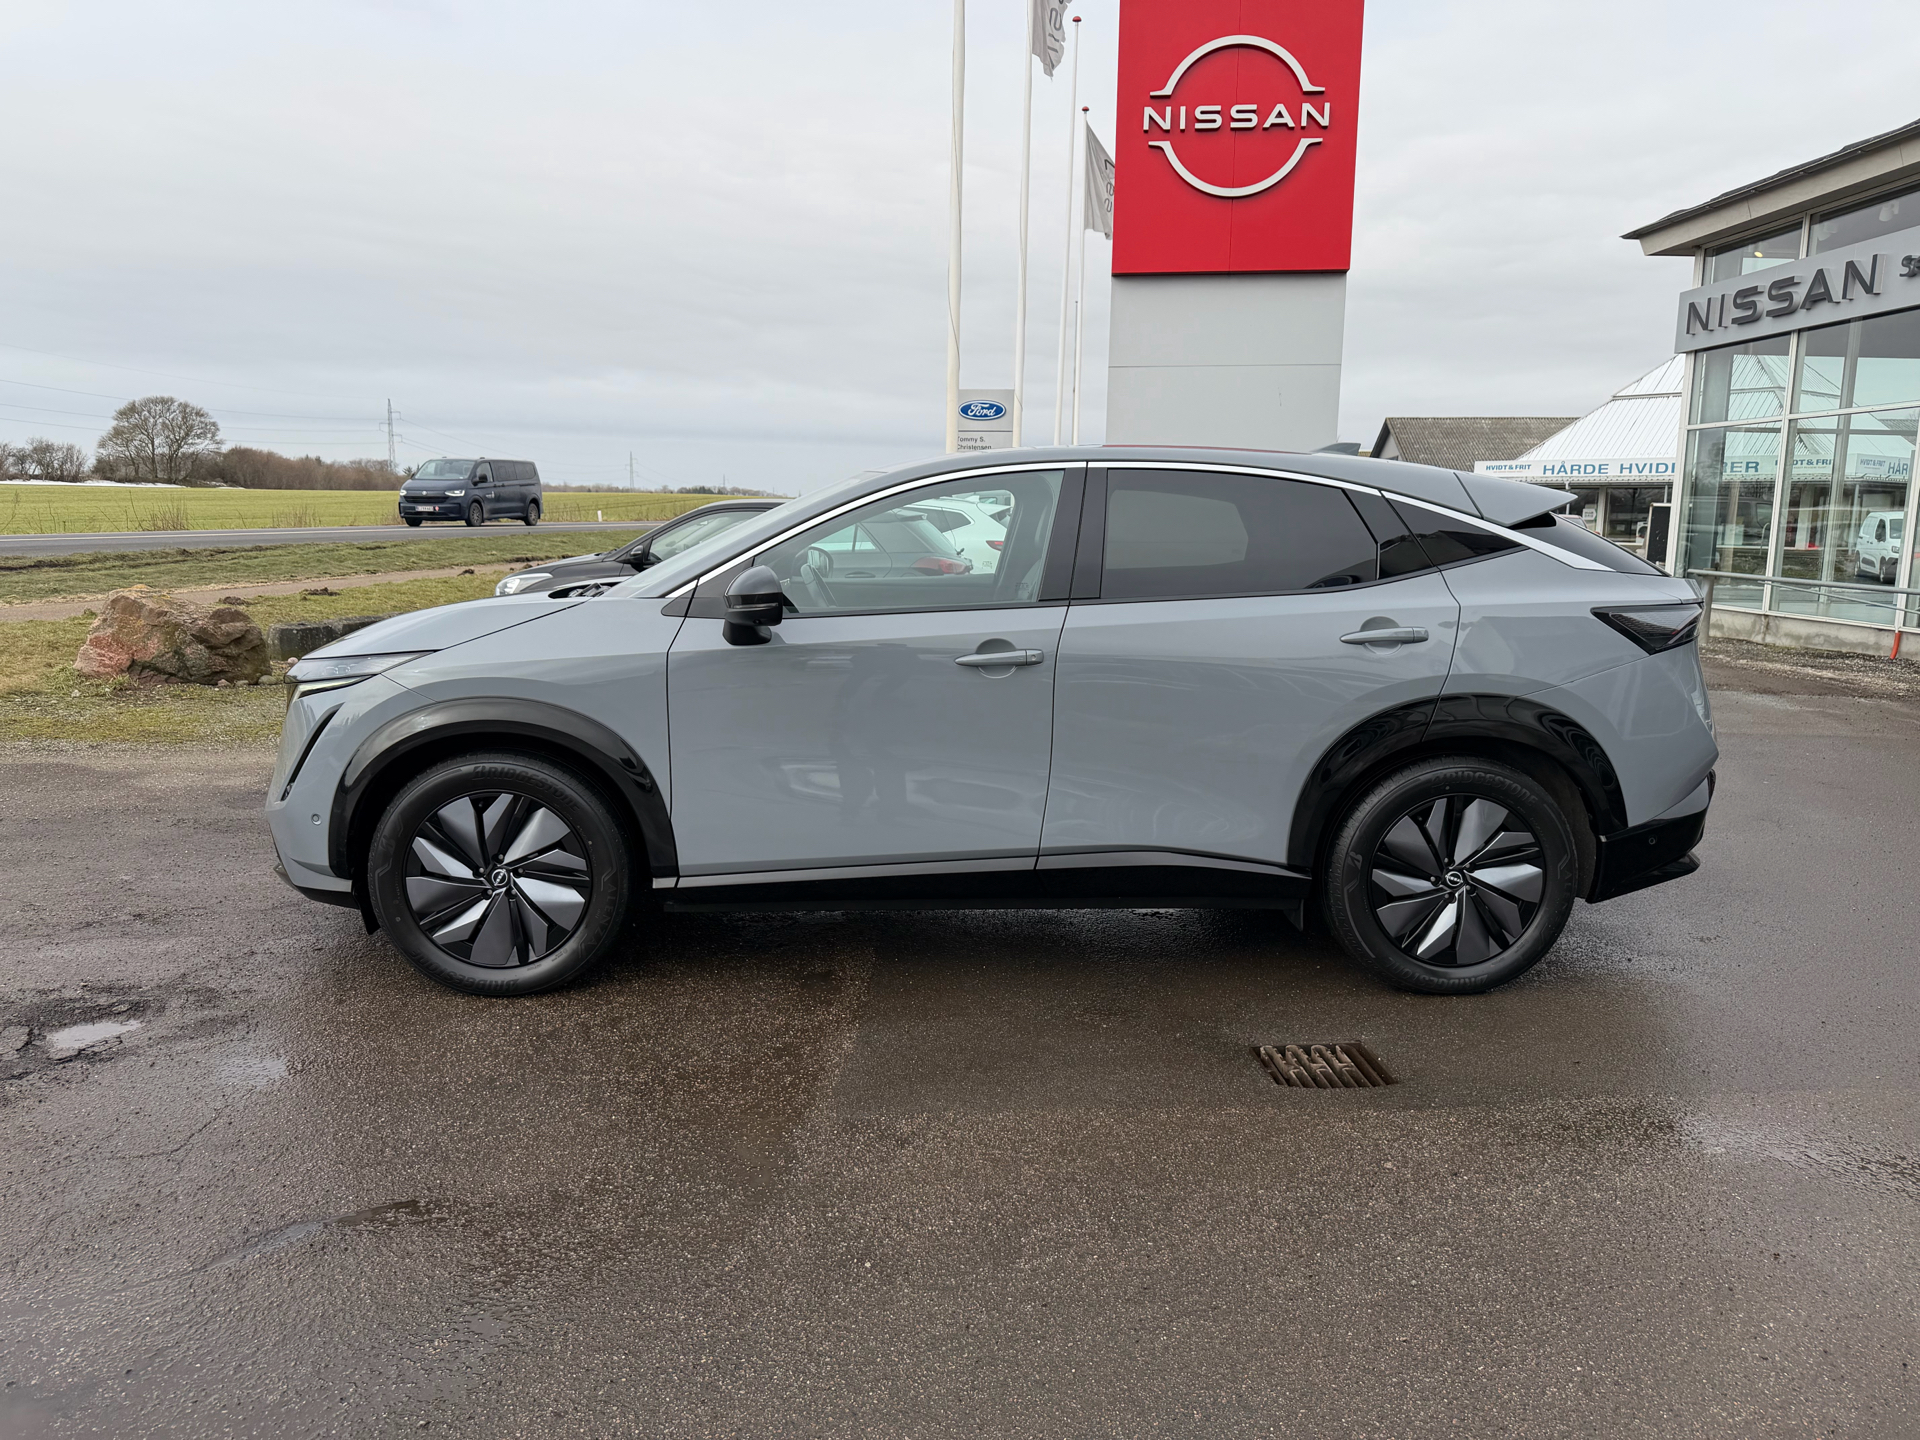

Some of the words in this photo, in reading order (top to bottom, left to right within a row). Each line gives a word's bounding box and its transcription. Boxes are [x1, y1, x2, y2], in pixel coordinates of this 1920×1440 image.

[1143, 102, 1331, 131] NISSAN
[1686, 253, 1887, 335] NISSAN
[968, 403, 997, 416] Ford
[1542, 461, 1609, 475] HÅRDE
[471, 764, 582, 813] BRIDGESTONE
[1432, 771, 1538, 806] BRIDGESTONE
